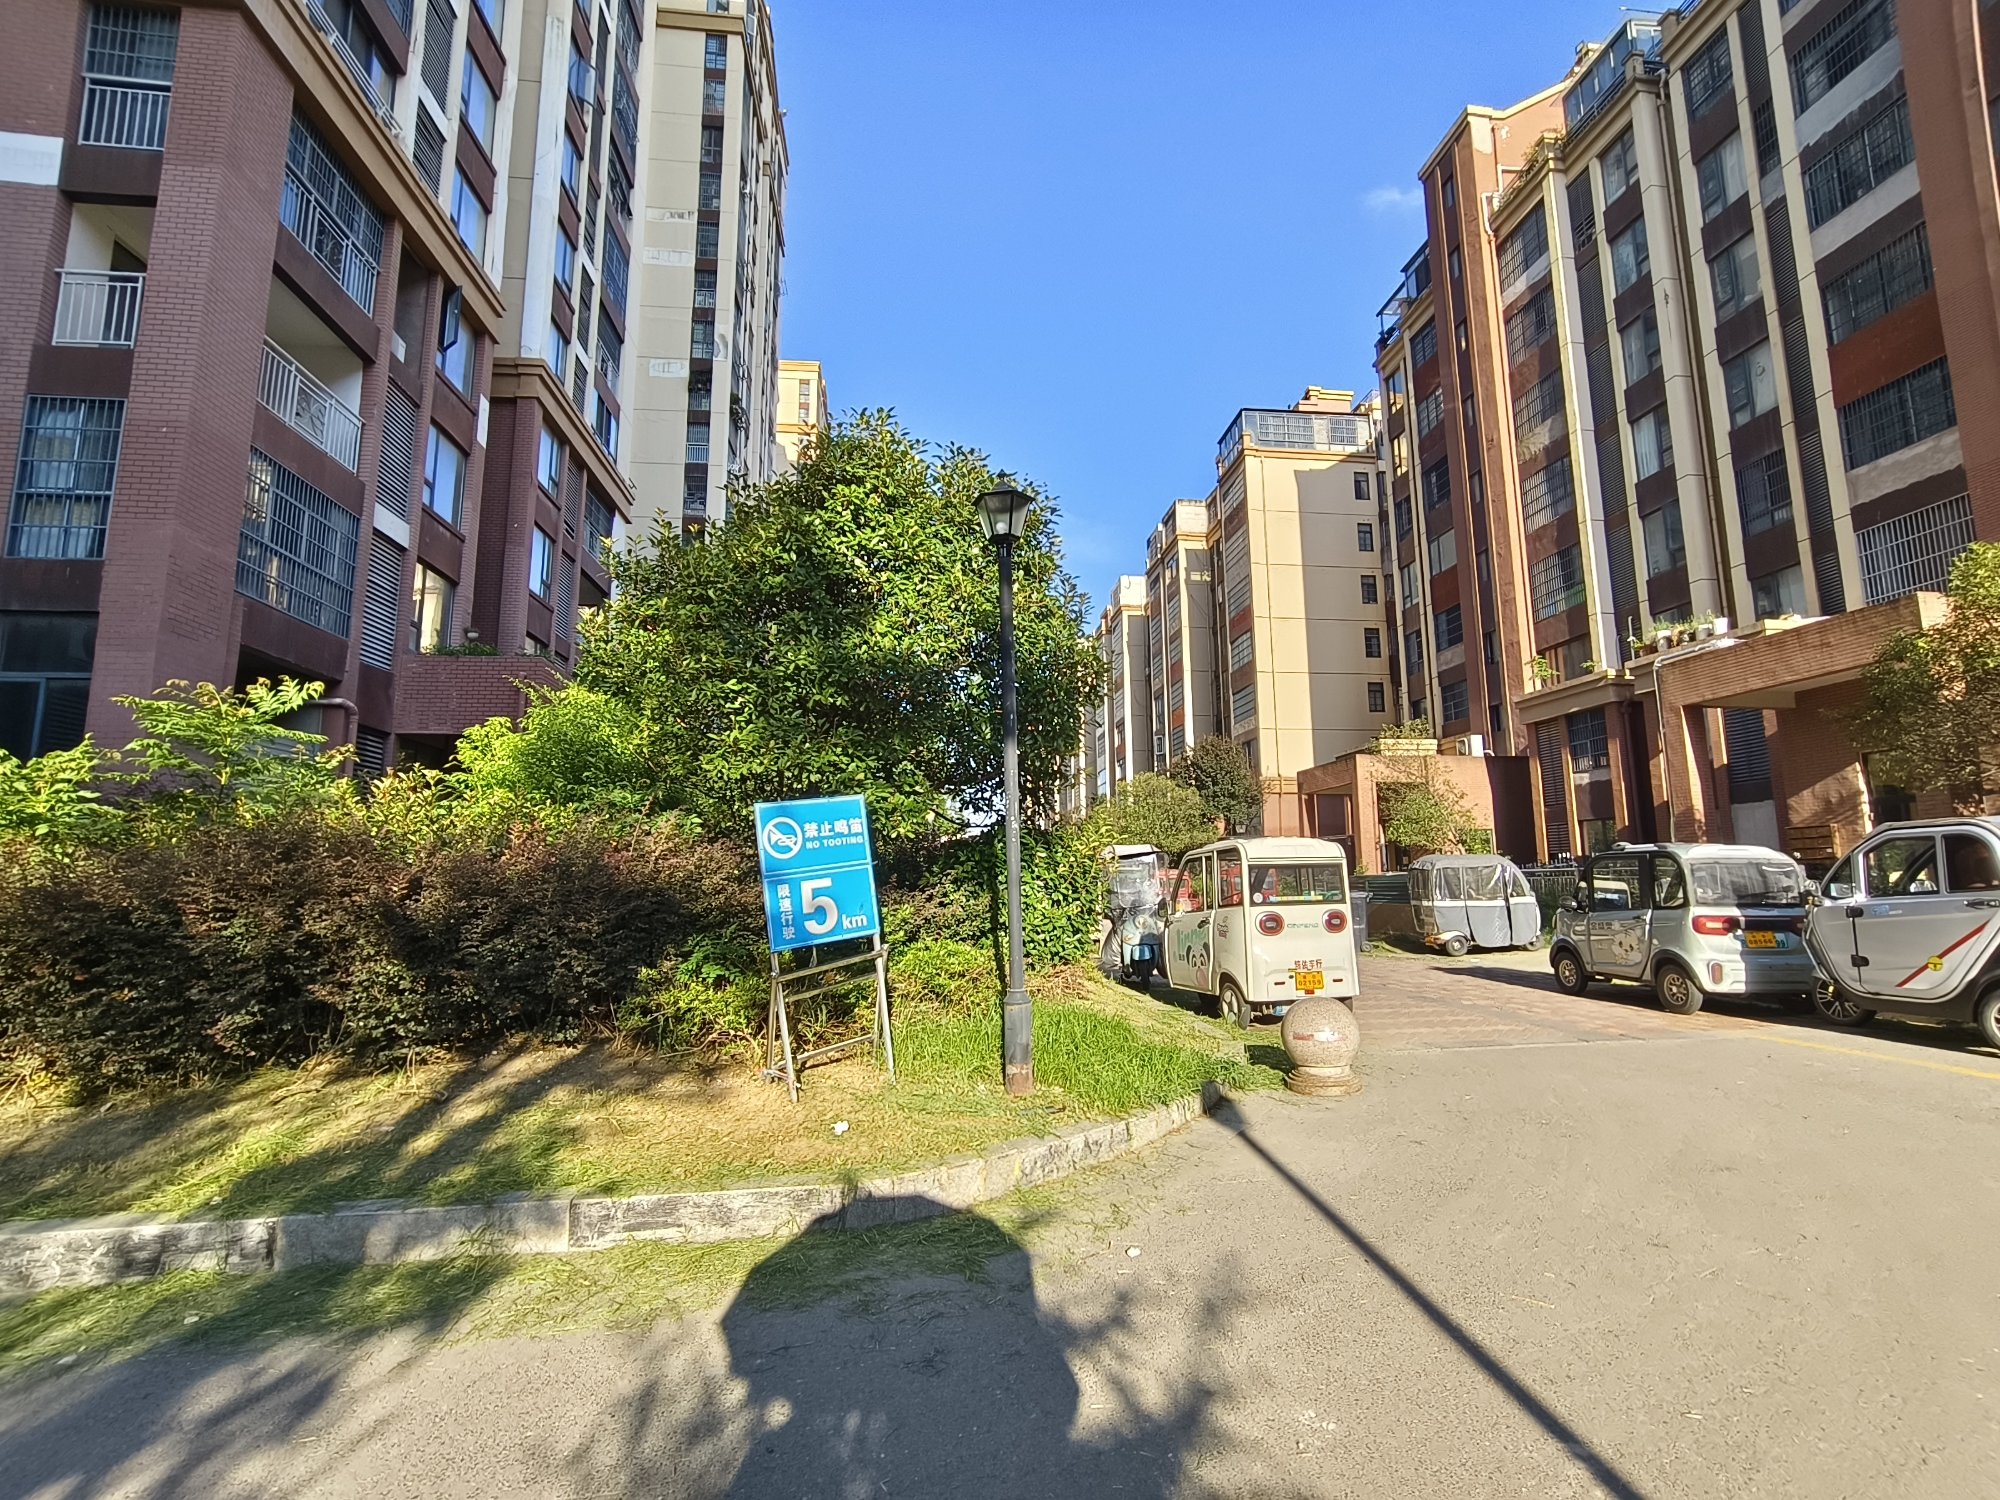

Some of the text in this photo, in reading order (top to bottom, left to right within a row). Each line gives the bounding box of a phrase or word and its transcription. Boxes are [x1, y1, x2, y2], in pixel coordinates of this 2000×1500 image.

[803, 817, 863, 839] 禁止鸣笛
[805, 835, 864, 850] NO TOOTING
[777, 883, 796, 940] 限速行驶
[800, 877, 868, 935] 5 km
